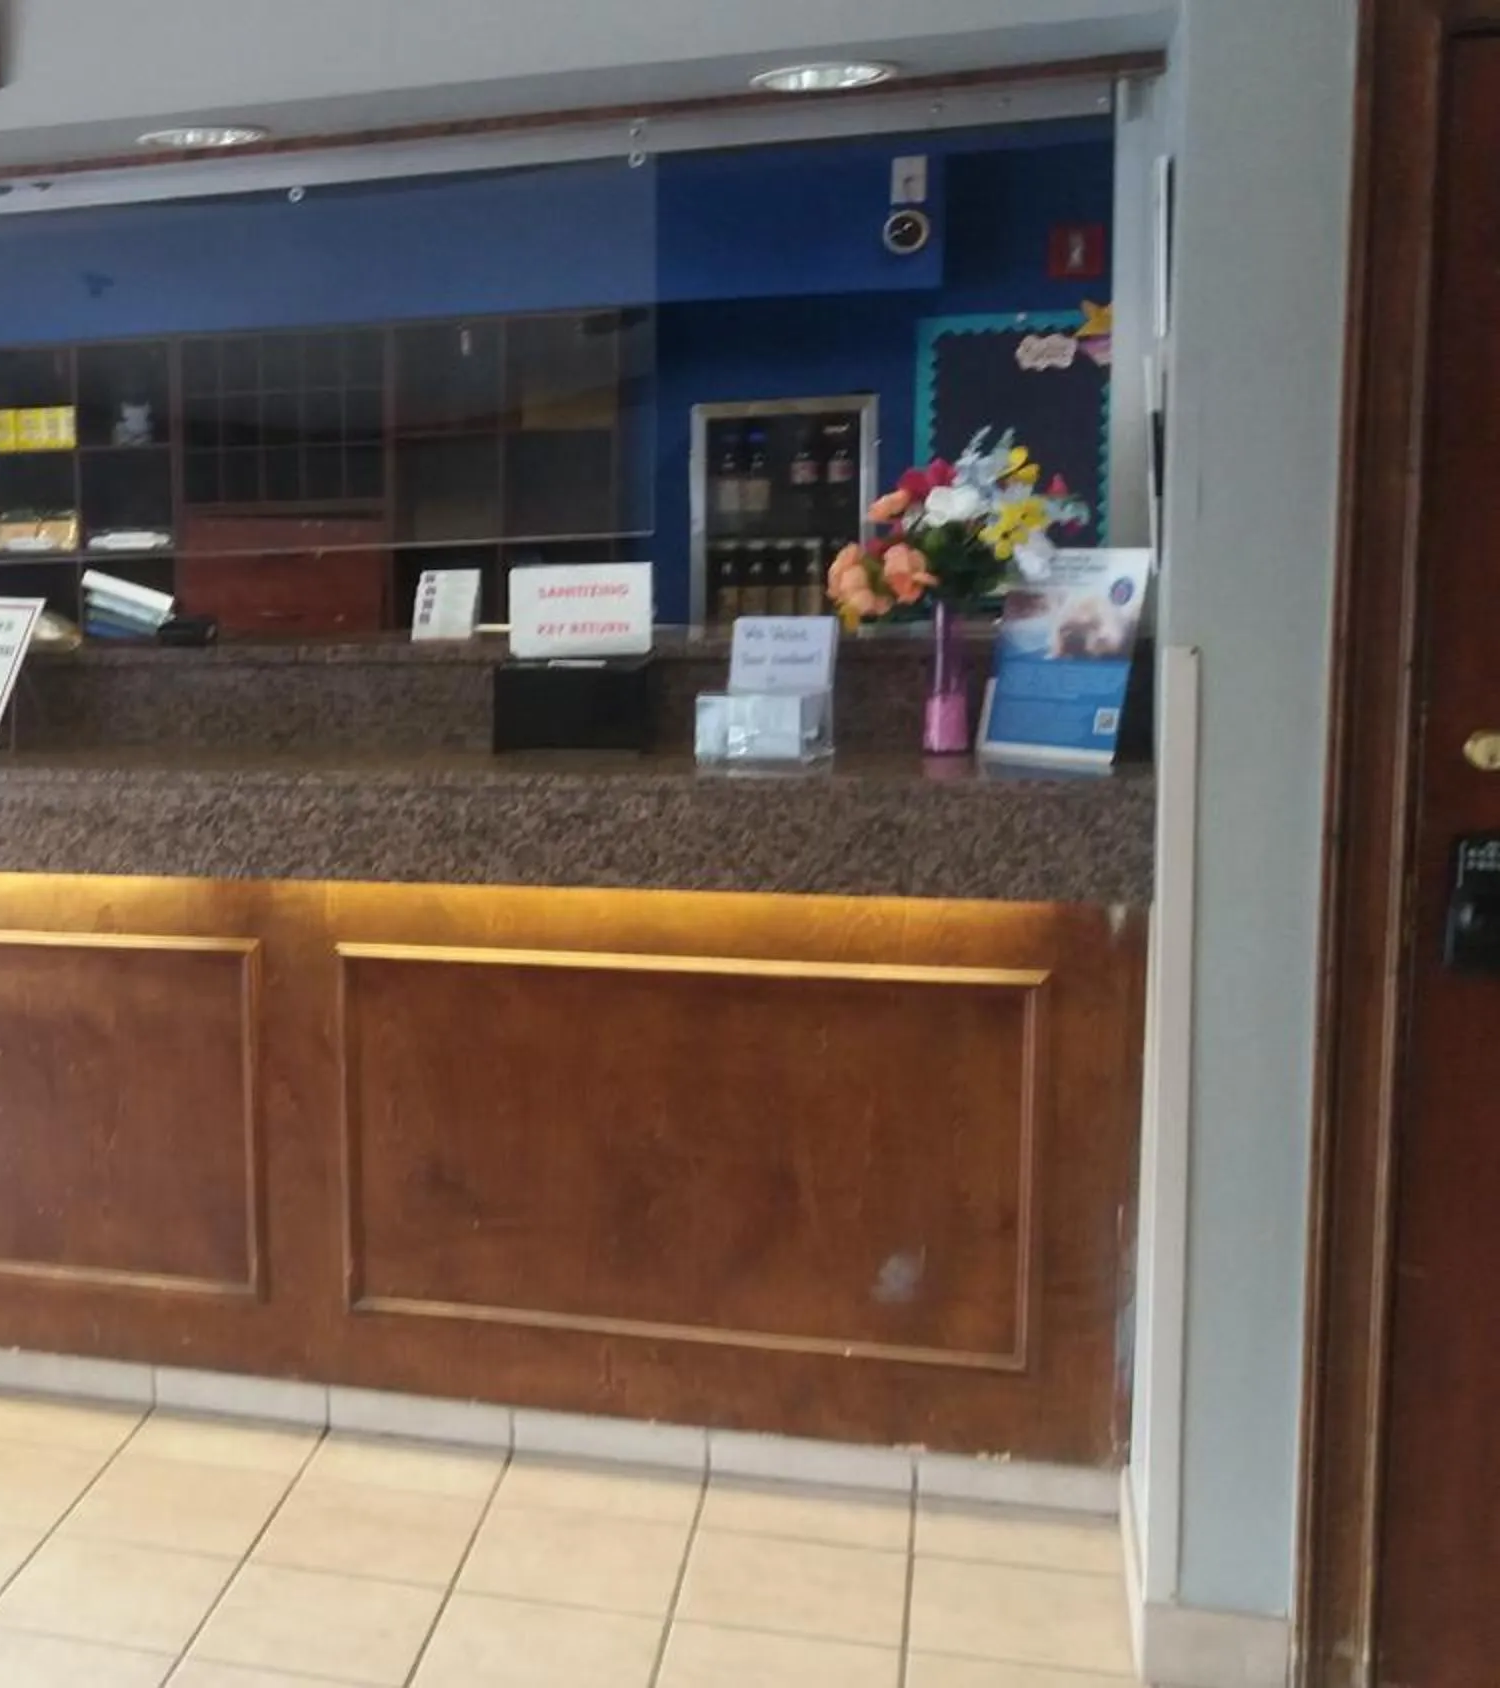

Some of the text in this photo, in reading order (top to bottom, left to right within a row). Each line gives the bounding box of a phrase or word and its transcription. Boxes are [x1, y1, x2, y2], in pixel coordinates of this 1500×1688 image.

[538, 583, 630, 601] SANITIZING
[536, 621, 631, 637] KEY RETURN
